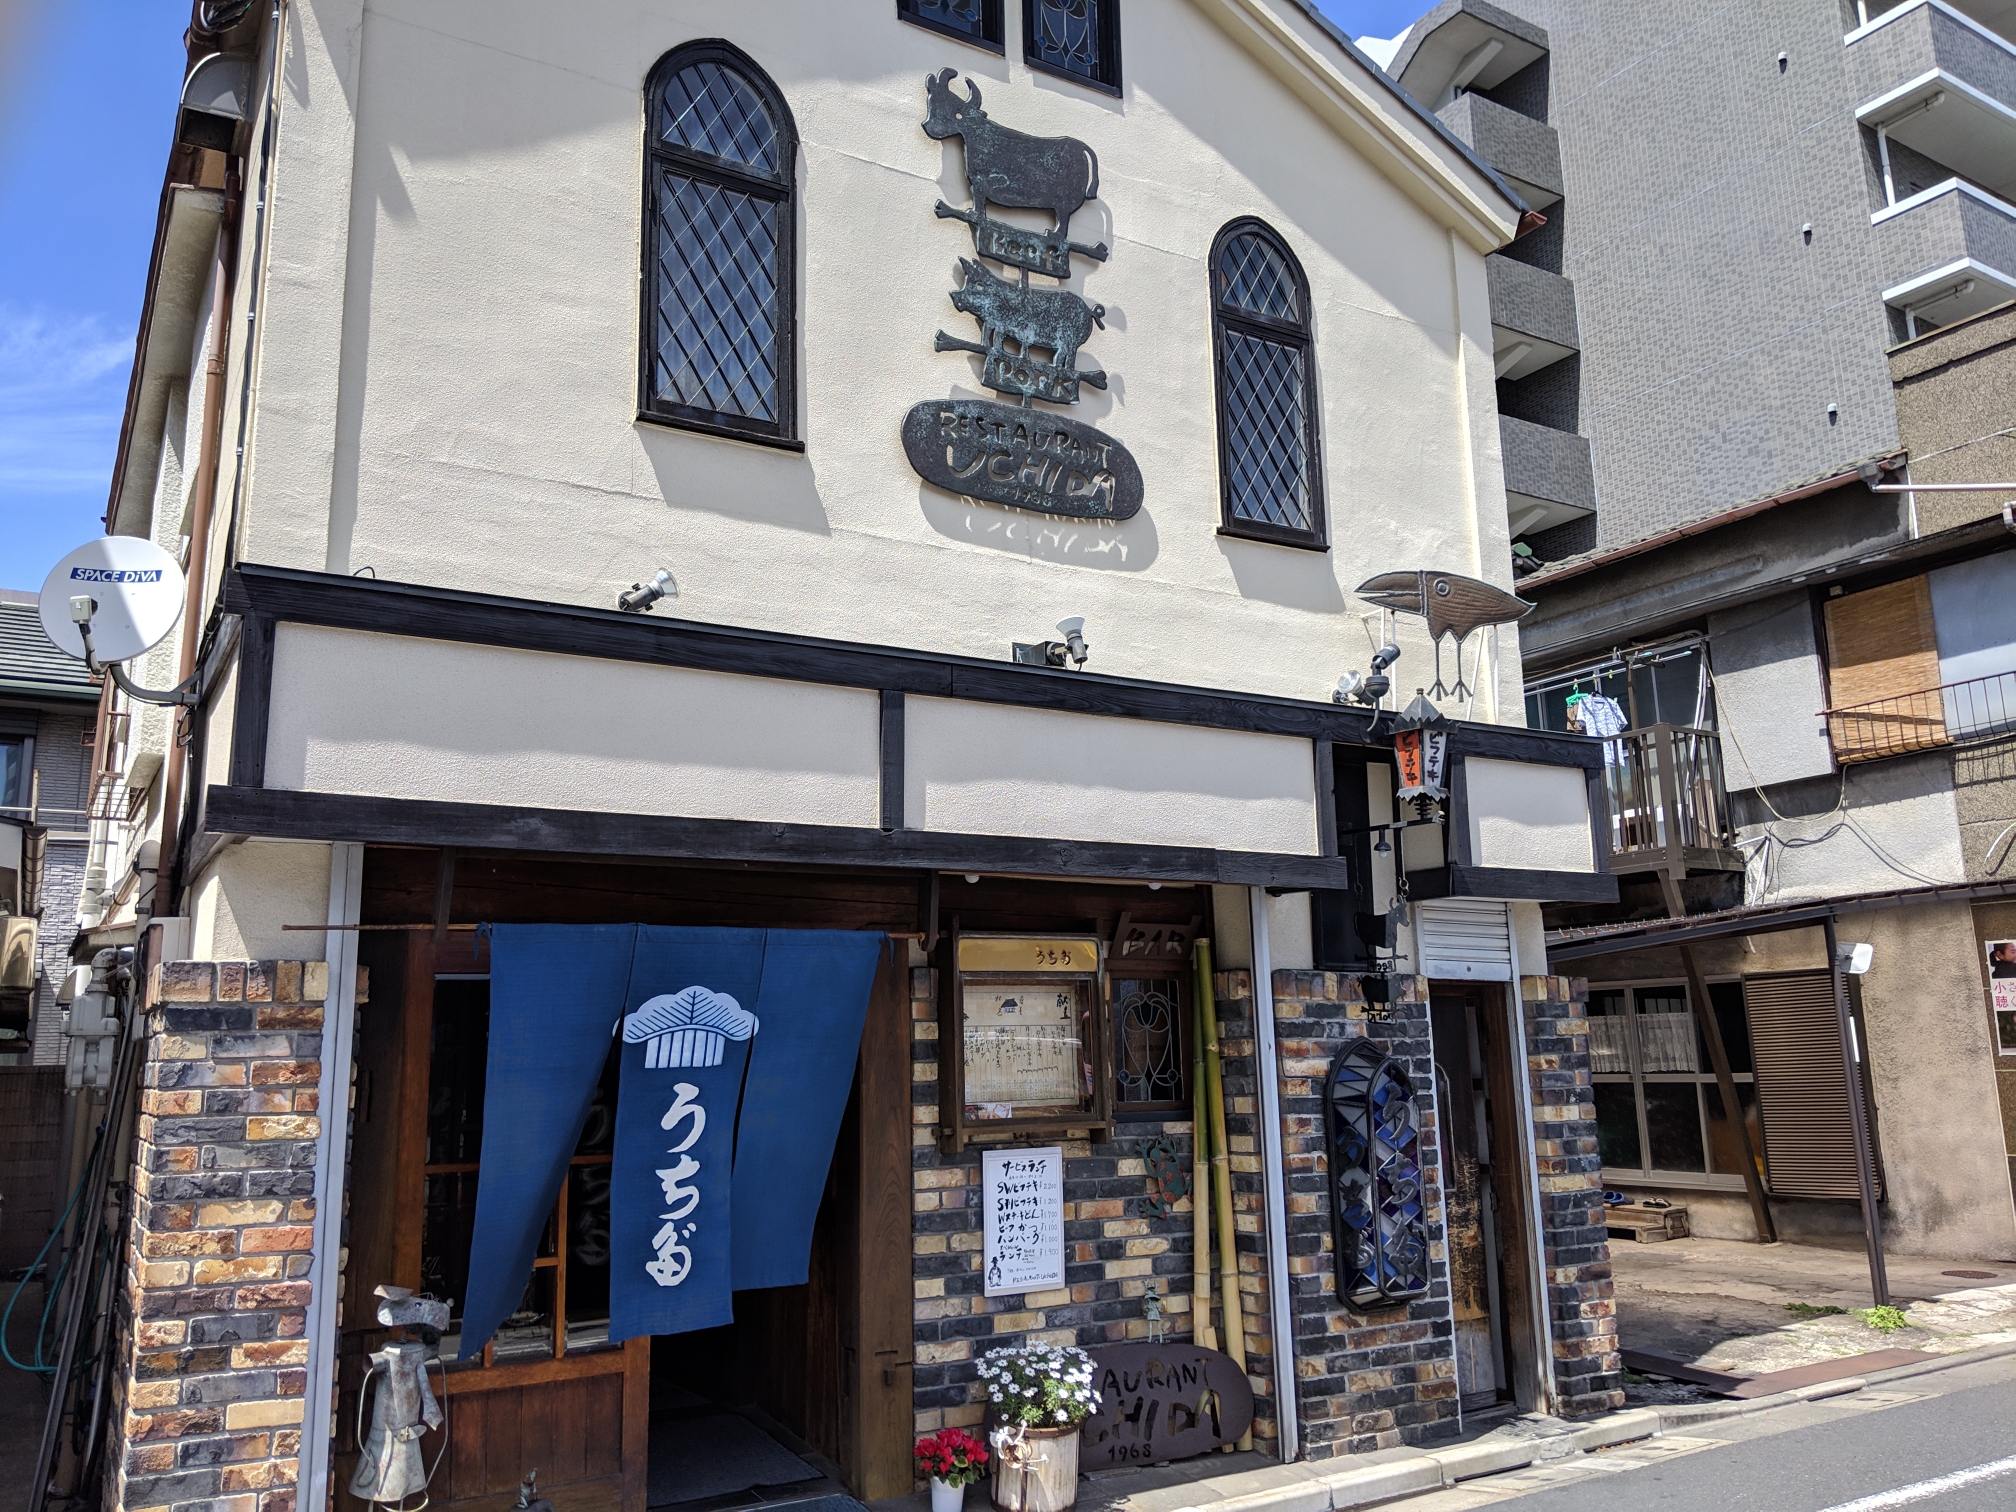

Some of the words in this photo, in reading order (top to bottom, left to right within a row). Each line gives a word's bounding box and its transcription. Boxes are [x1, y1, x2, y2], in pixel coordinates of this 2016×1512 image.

[939, 411, 1113, 468] RESTAURANT
[946, 444, 1116, 512] UCHIDA
[75, 568, 120, 582] SPACE
[1426, 730, 1444, 783] ビフテキ
[1122, 927, 1186, 957] BAR
[1101, 1357, 1213, 1398] AURANT
[1080, 1388, 1222, 1448] CHIDA
